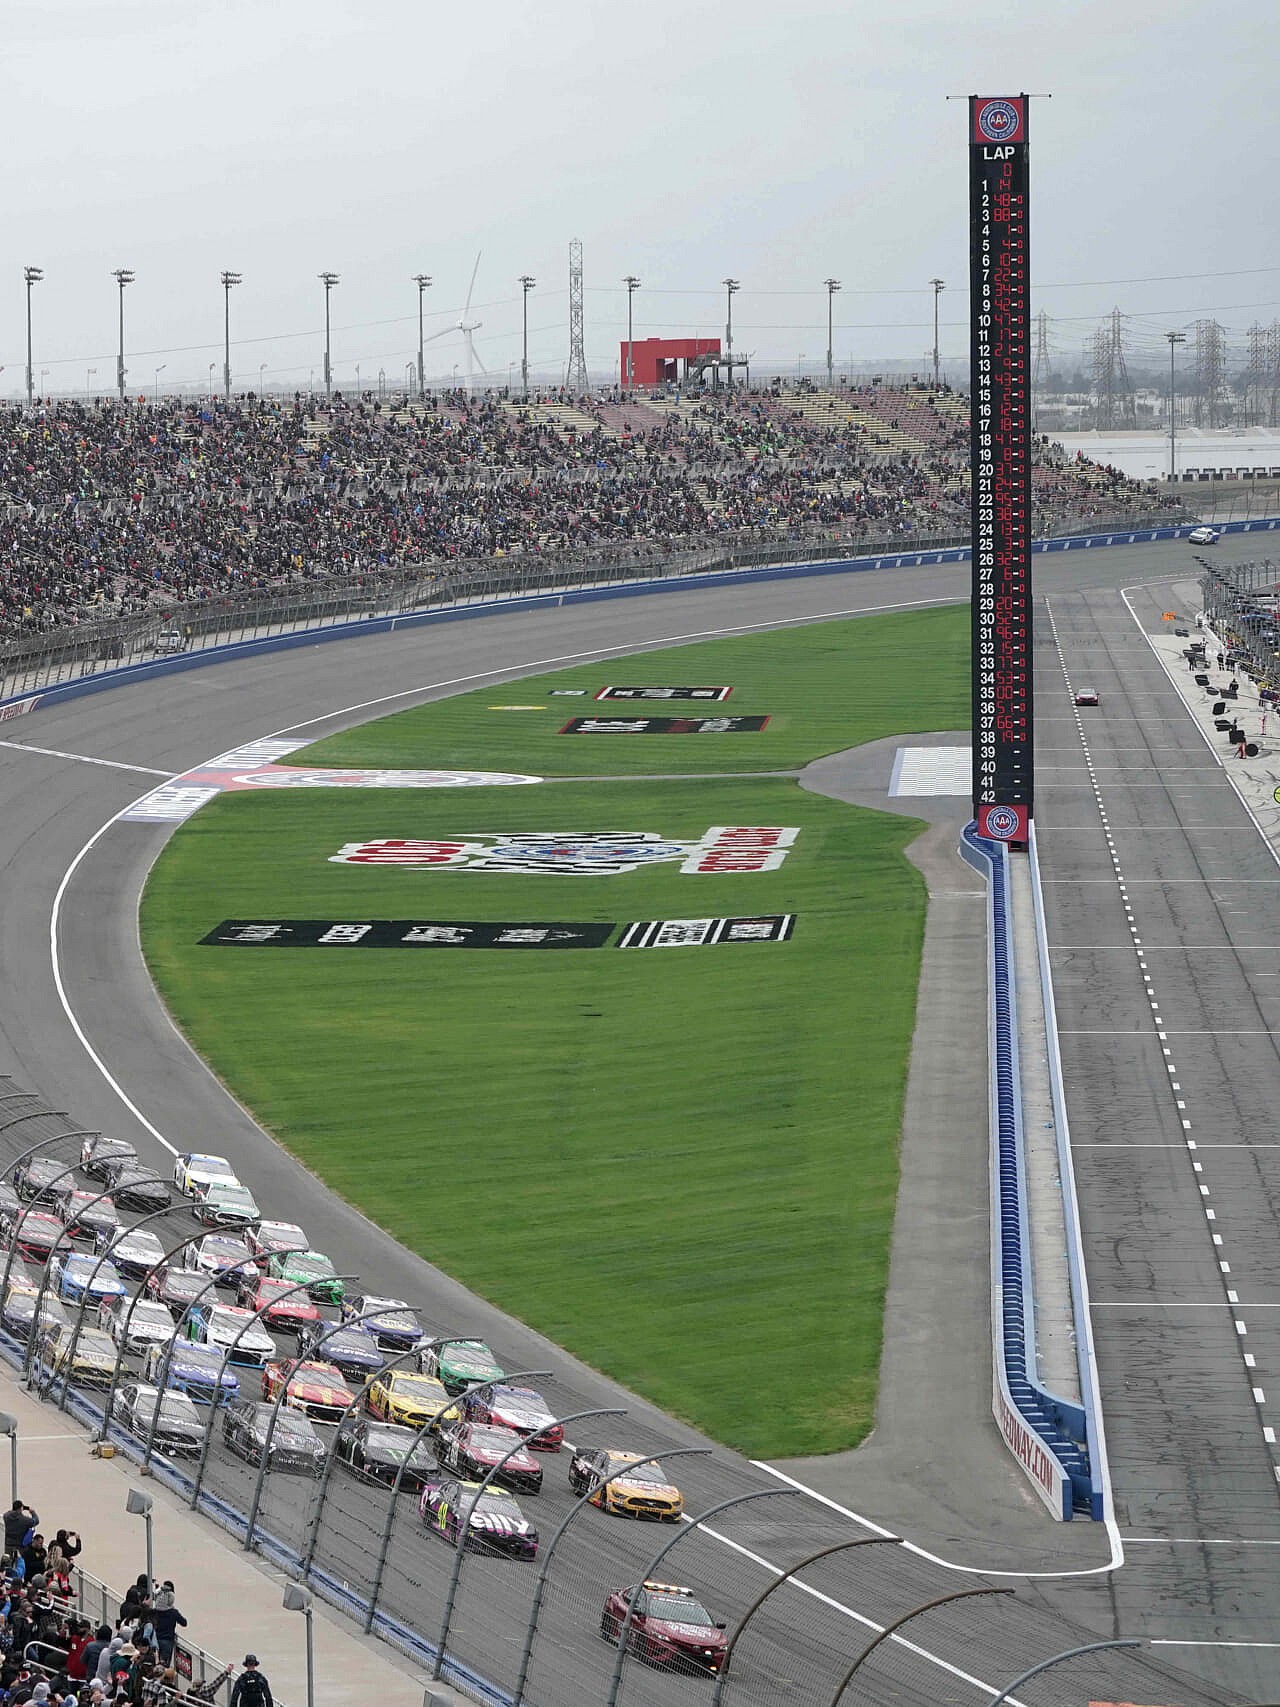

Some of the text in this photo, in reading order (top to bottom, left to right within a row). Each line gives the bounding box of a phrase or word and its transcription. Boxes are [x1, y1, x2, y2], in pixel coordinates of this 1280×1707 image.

[990, 113, 1008, 125] AAA
[983, 146, 1015, 160] LAP
[1003, 163, 1012, 177] 0
[981, 179, 987, 191] 1
[983, 194, 990, 206] 2
[983, 209, 990, 221] 3
[983, 224, 990, 235] 4
[983, 239, 990, 251] 5
[983, 254, 990, 266] 6
[983, 269, 990, 281] 7
[983, 284, 991, 296] 8
[983, 299, 991, 311] 9
[979, 314, 991, 326] 10
[979, 329, 988, 341] 11
[979, 344, 991, 356] 12
[979, 359, 991, 371] 13
[979, 374, 991, 386] 14
[979, 389, 991, 401] 15
[979, 403, 992, 416] 16
[979, 418, 991, 431] 17
[979, 433, 992, 445] 18
[979, 448, 992, 460] 19
[979, 463, 994, 475] 20
[980, 478, 991, 490] 21
[979, 493, 993, 505] 22
[980, 508, 994, 520] 23
[980, 523, 994, 535] 24
[980, 538, 994, 550] 25
[980, 553, 994, 565] 26
[980, 568, 993, 580] 27
[980, 583, 994, 595] 28
[980, 597, 994, 609] 29
[980, 612, 995, 624] 30
[981, 627, 992, 639] 31
[981, 642, 995, 654] 32
[981, 656, 995, 669] 33
[981, 671, 996, 684] 34
[981, 686, 995, 698] 35
[981, 701, 996, 713] 36
[981, 716, 994, 728] 37
[981, 731, 996, 743] 38
[981, 745, 996, 758] 39
[981, 760, 996, 772] 40
[981, 775, 993, 787] 41
[981, 790, 996, 802] 42
[712, 827, 784, 848] AUTO
[345, 840, 468, 863] 400
[697, 849, 775, 872] CLUB
